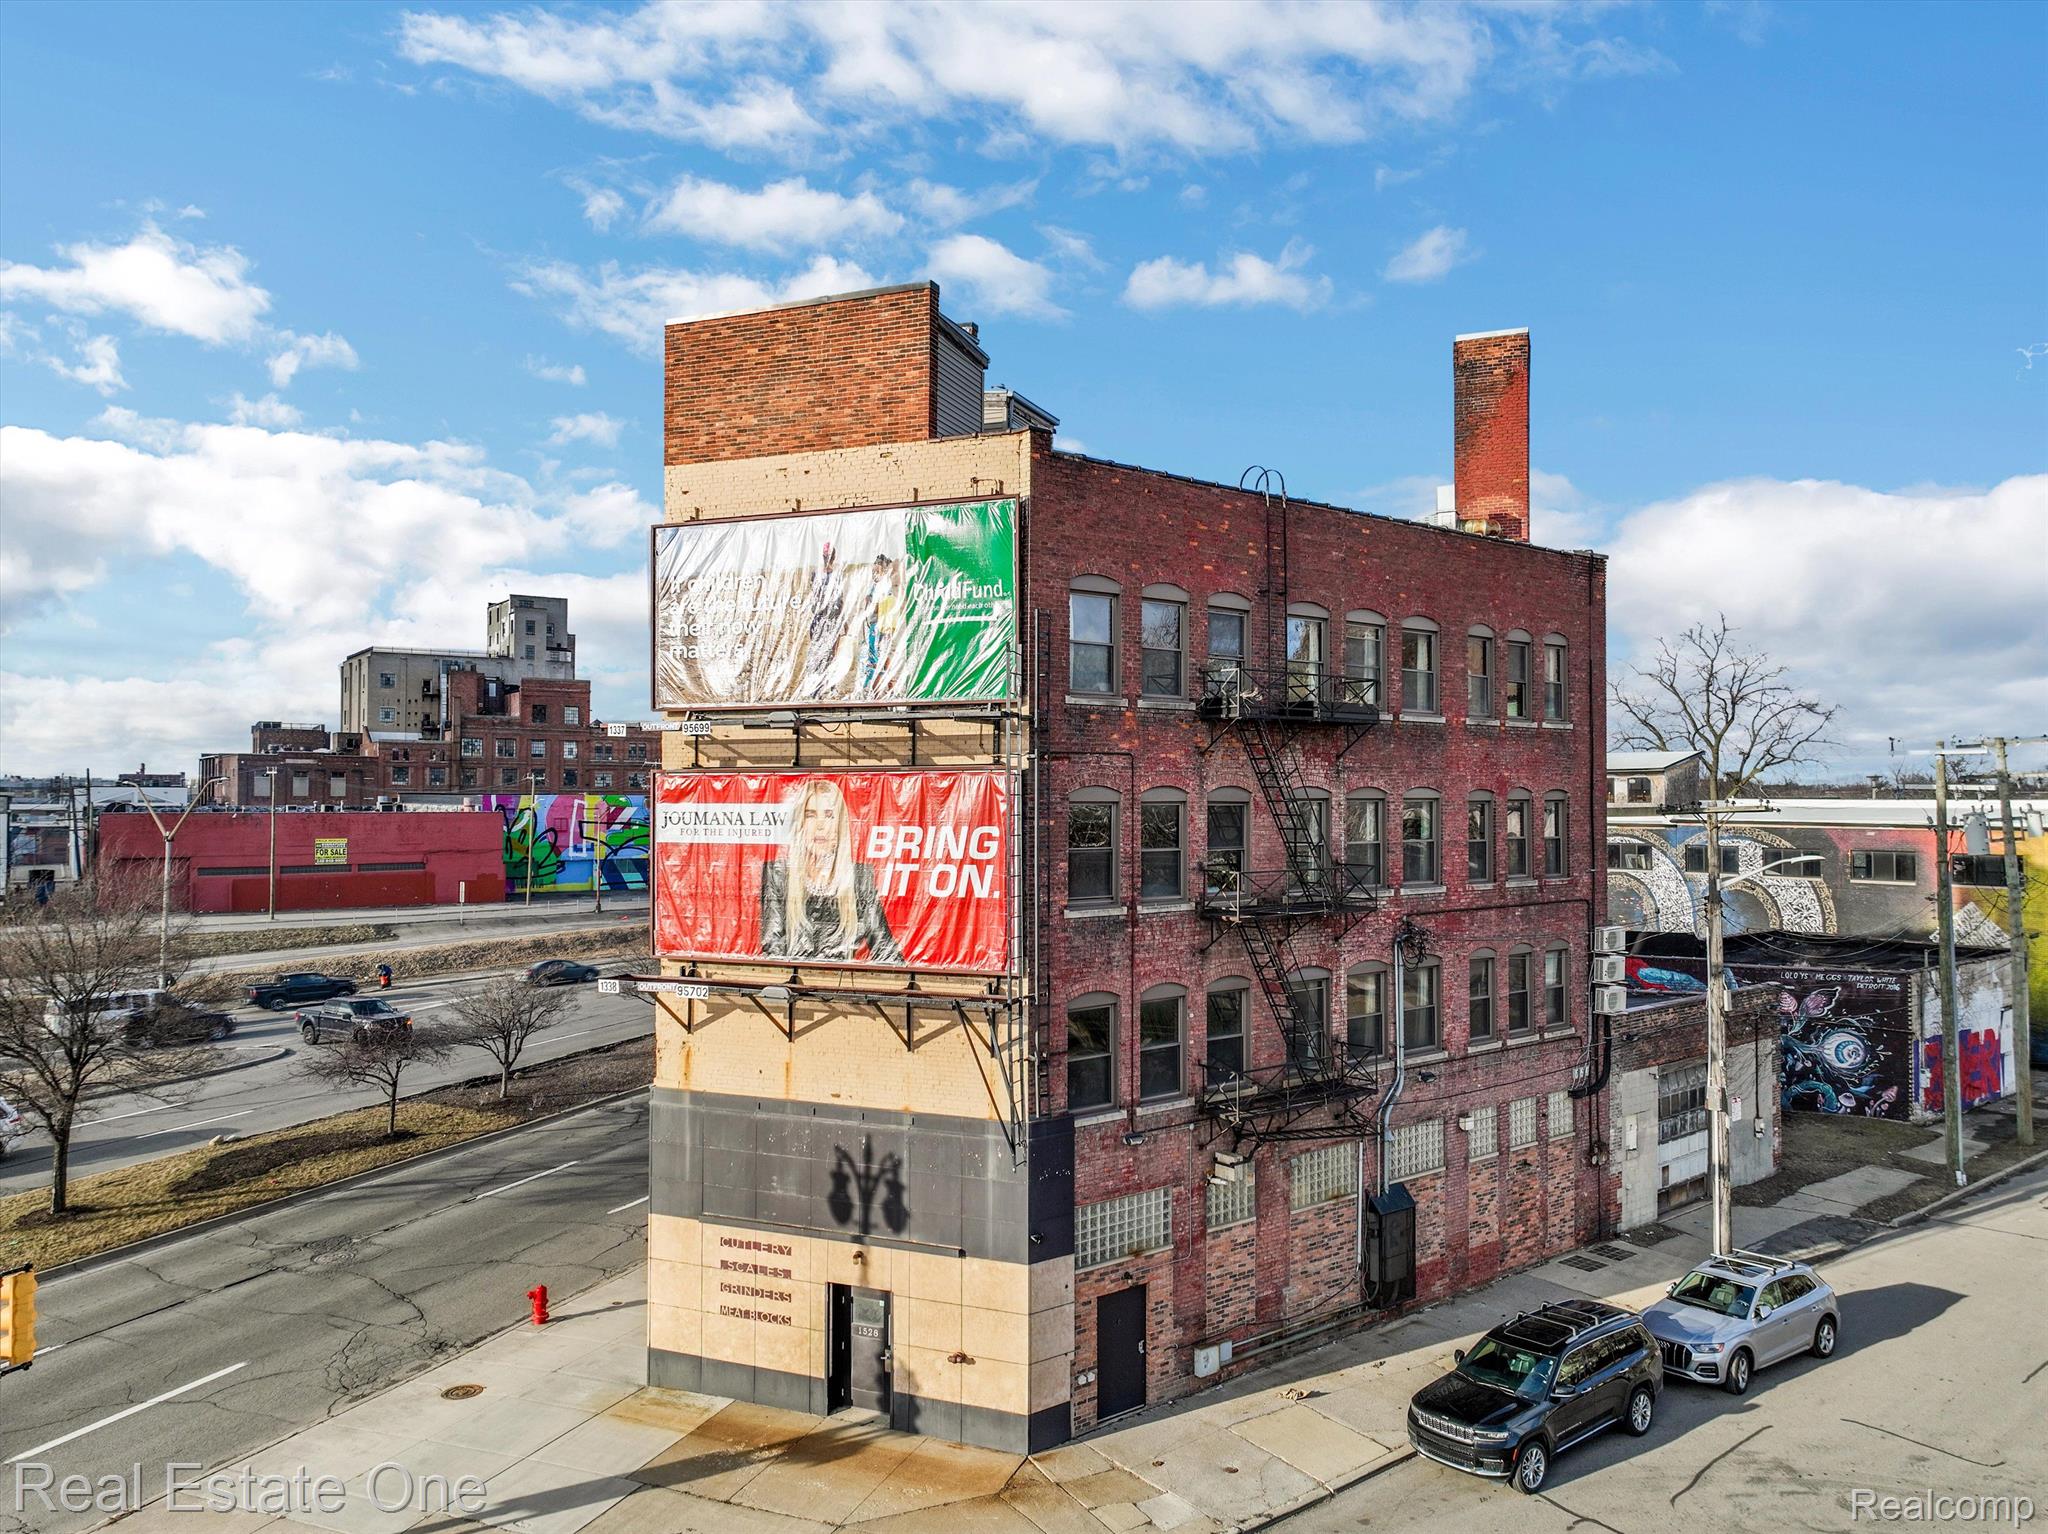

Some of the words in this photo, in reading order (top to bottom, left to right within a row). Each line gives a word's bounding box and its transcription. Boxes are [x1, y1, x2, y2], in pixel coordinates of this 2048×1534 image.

[609, 725, 625, 735] 1337
[683, 723, 710, 733] 95699
[661, 811, 745, 829] JOUMANA
[749, 811, 787, 826] LAW
[680, 828, 701, 837] FOR
[703, 828, 723, 836] THE
[727, 828, 772, 838] INJURED
[866, 825, 1000, 860] BRING
[880, 862, 920, 897] IT
[928, 863, 1001, 899] ON.
[1815, 973, 1842, 982] MEGGS
[1848, 974, 1875, 983] TAYLOR
[600, 981, 618, 992] 1338
[677, 985, 708, 998] 95702
[1856, 982, 1886, 990] DETROIT
[721, 1236, 792, 1256] CUTLERY
[727, 1260, 785, 1278] SCALES
[721, 1282, 792, 1302] GRINDERS
[720, 1304, 748, 1320] MEAT
[749, 1310, 792, 1327] BLOCKS
